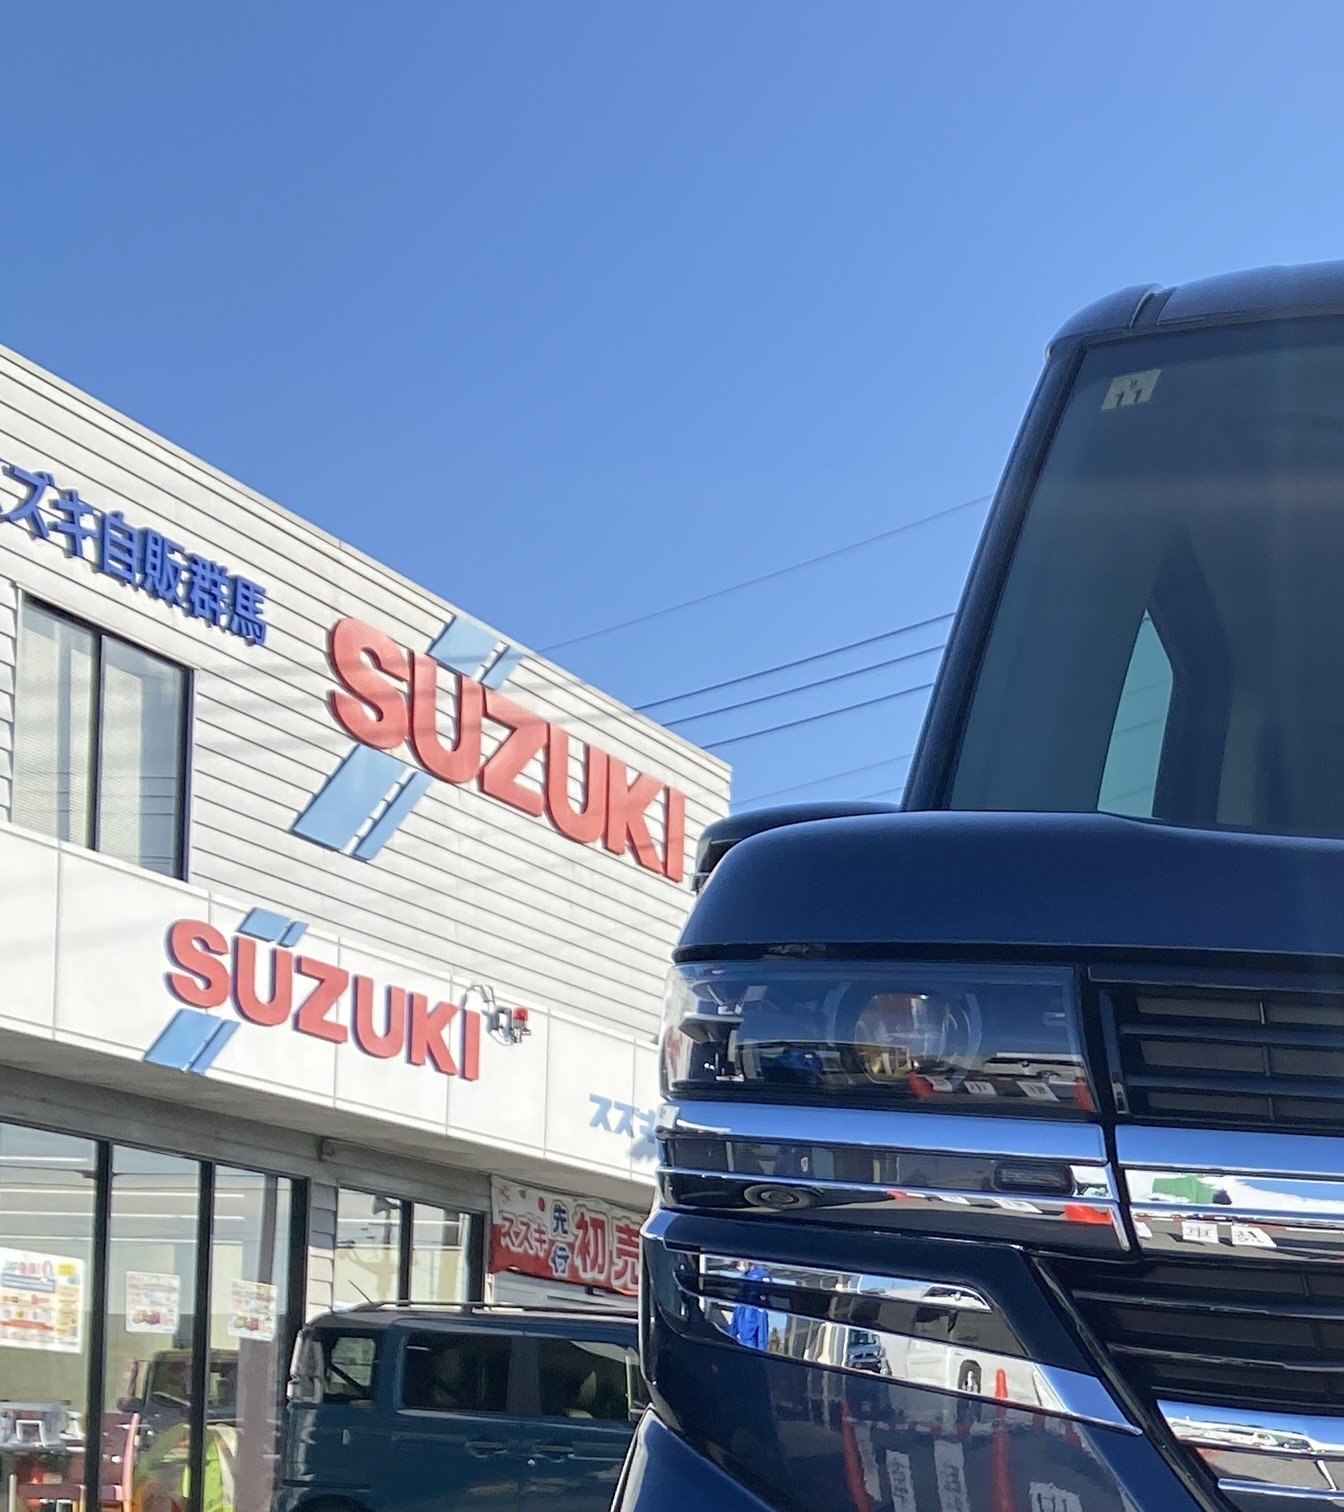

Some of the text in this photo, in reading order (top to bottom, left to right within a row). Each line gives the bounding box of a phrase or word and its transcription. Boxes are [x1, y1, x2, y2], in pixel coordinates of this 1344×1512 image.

[0, 463, 267, 646] ズキ自販群馬
[327, 616, 687, 882] SUZUKI
[165, 917, 480, 1082] SUZUKI
